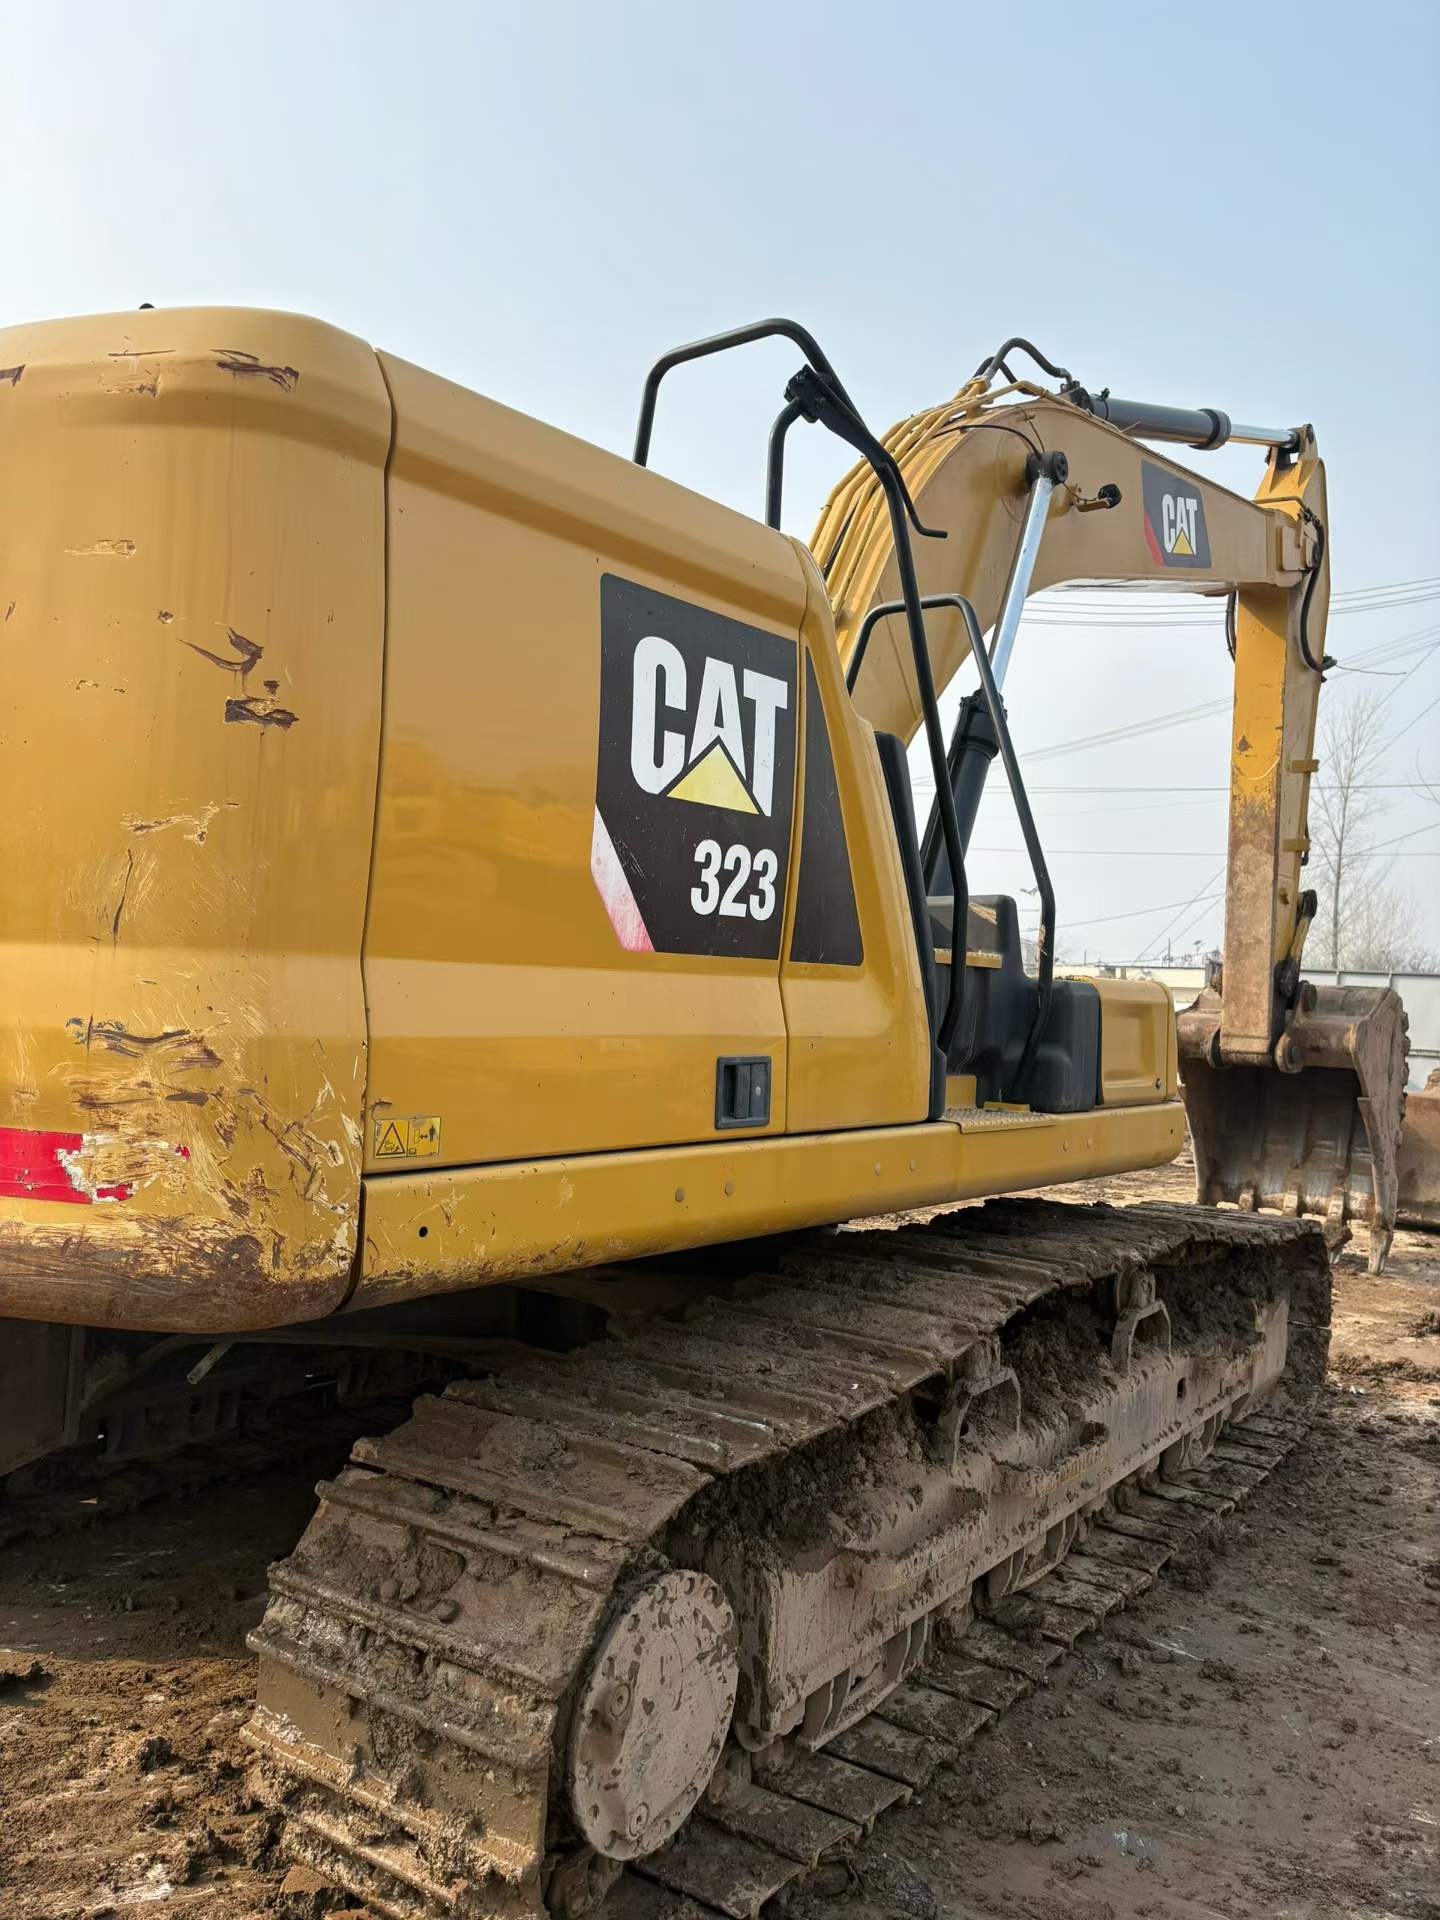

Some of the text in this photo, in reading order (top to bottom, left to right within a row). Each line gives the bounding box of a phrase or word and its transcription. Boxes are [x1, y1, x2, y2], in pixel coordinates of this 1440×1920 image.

[1162, 494, 1197, 555] CAT
[630, 636, 788, 817] CAT
[690, 839, 778, 921] 323
